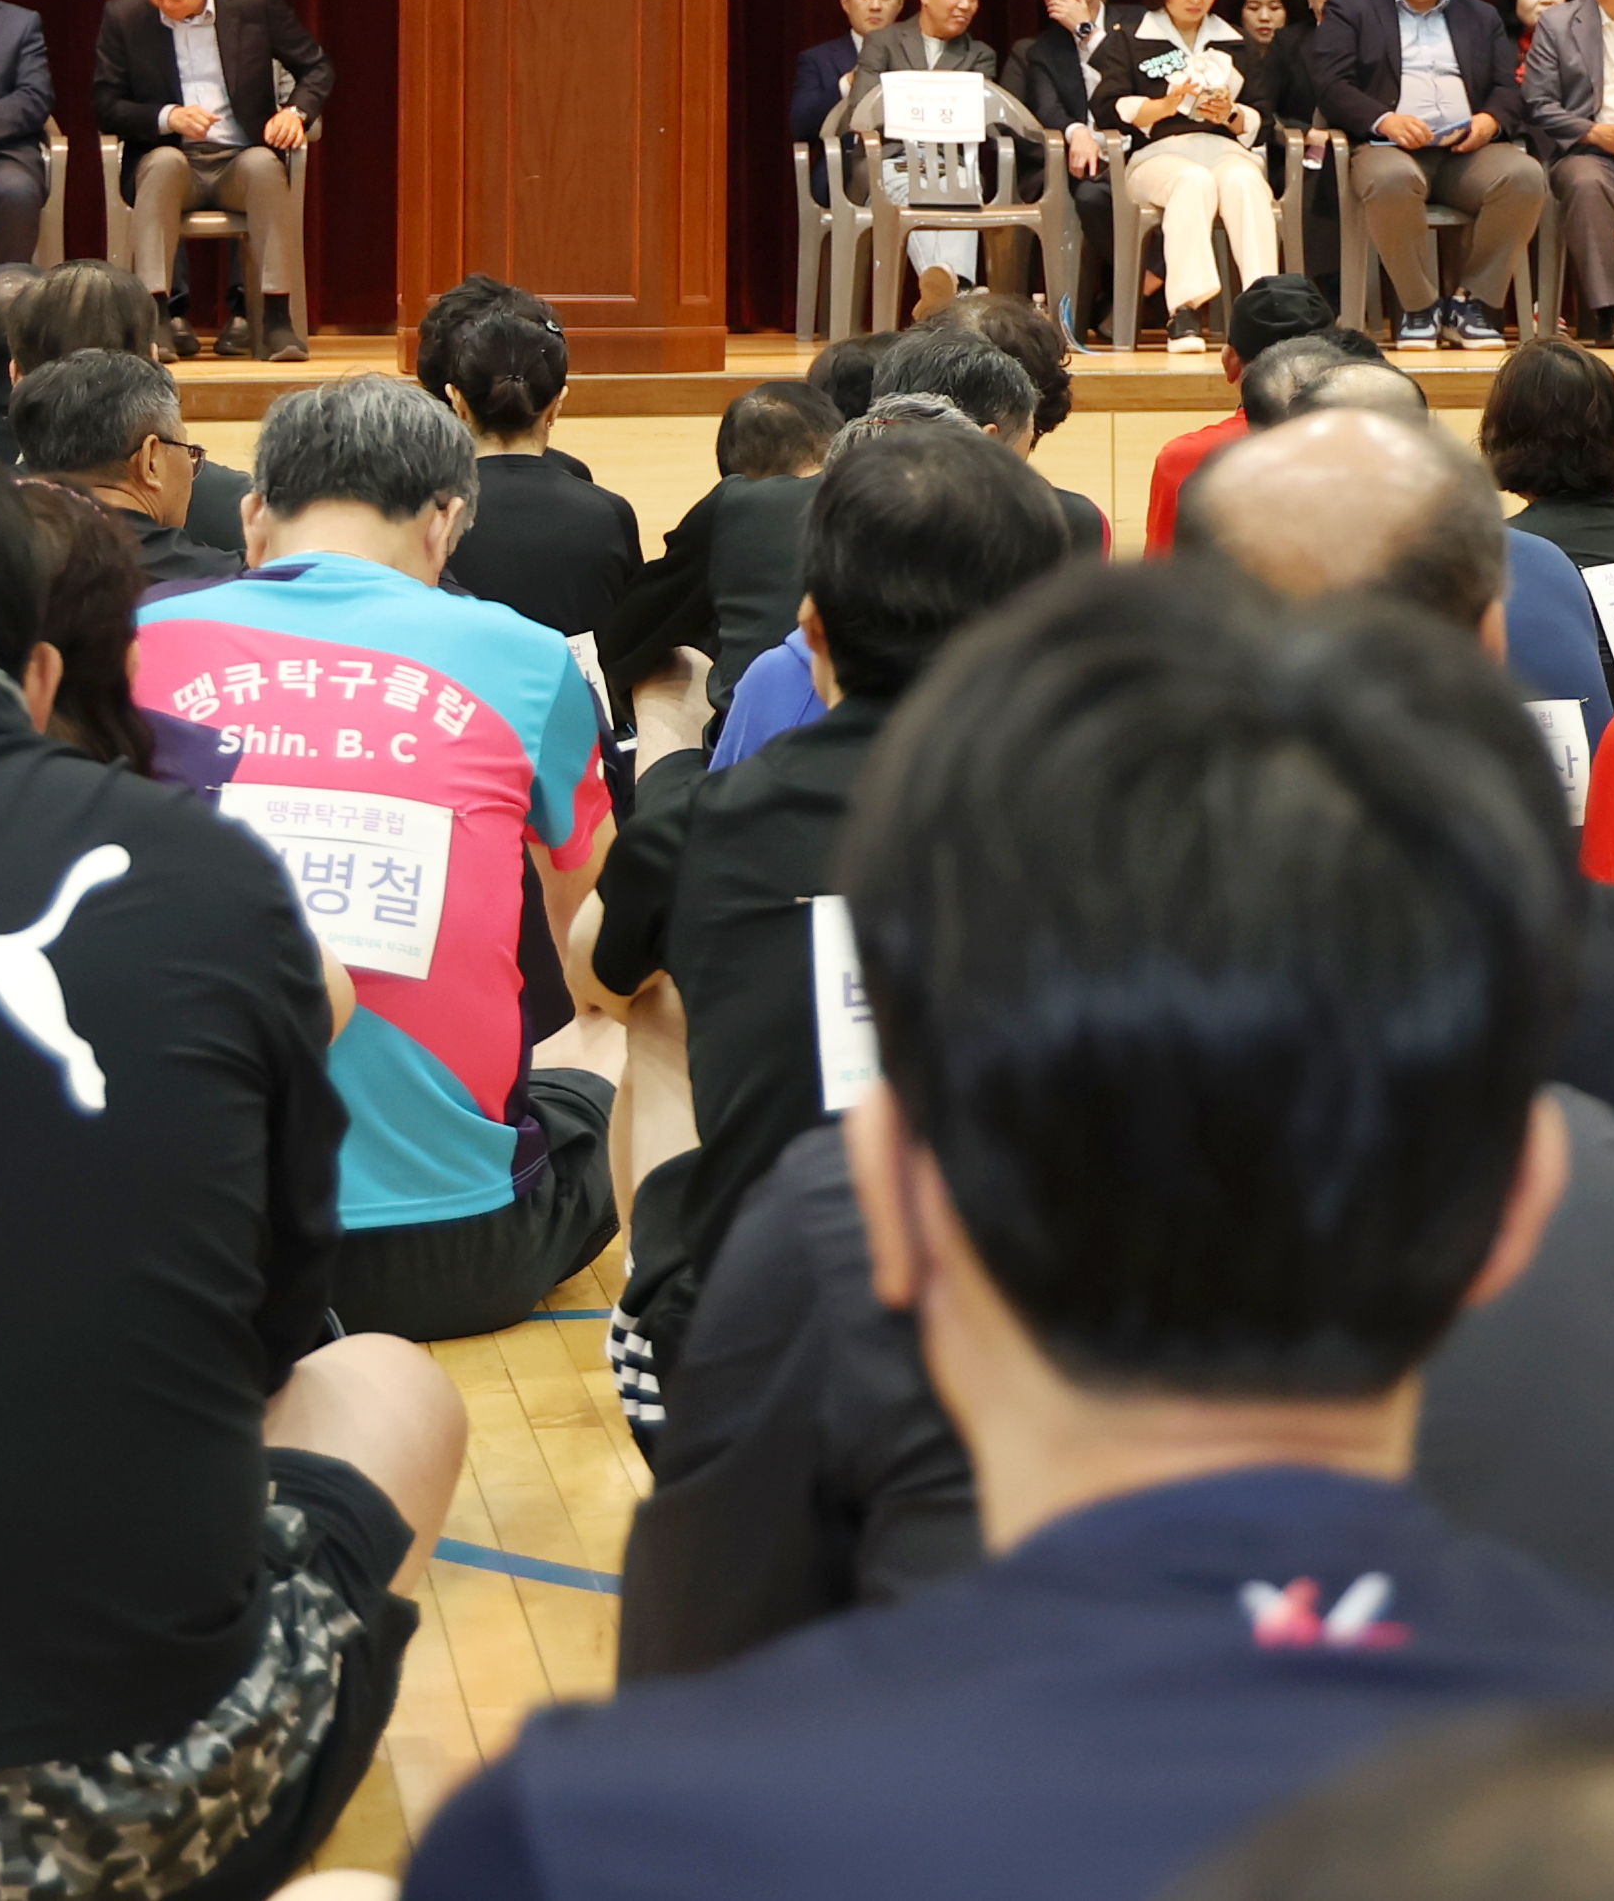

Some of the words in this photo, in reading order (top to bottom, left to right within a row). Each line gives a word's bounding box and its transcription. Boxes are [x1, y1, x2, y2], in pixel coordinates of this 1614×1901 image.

[173, 658, 478, 738] 땡큐탁구클럽
[218, 724, 318, 758] Shin.
[336, 728, 375, 759] B.
[390, 732, 419, 764] C
[266, 800, 406, 836] 땡큐탁구클럽
[279, 846, 424, 928] 병철
